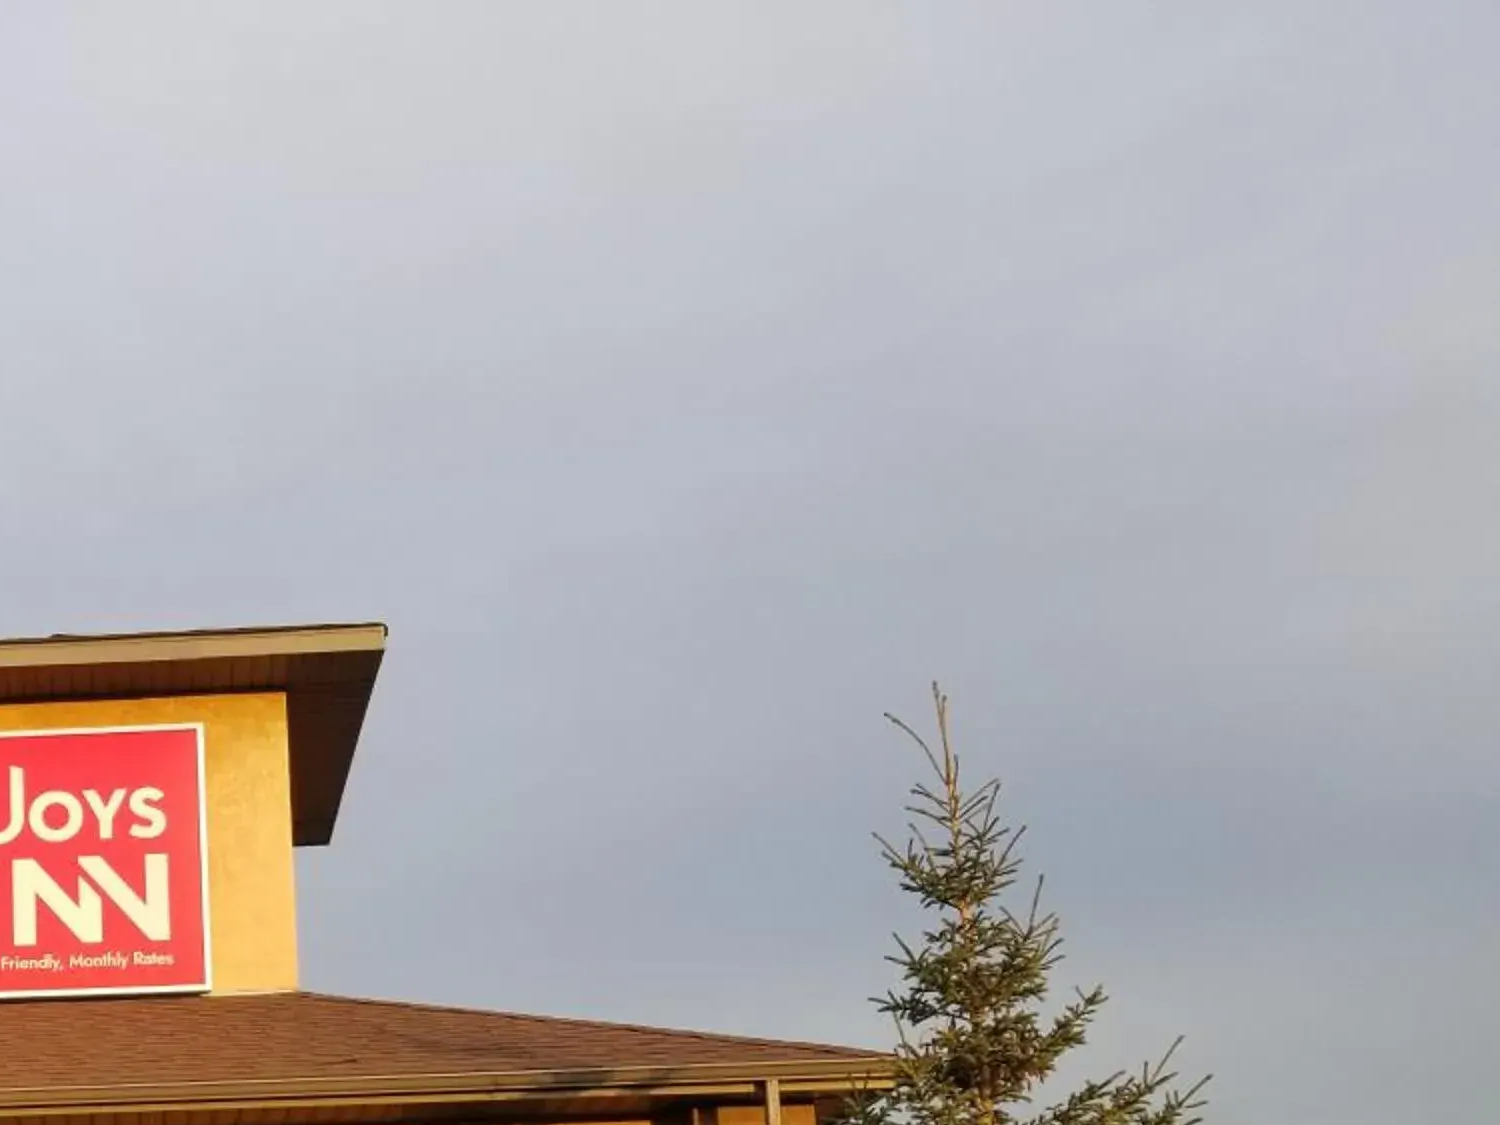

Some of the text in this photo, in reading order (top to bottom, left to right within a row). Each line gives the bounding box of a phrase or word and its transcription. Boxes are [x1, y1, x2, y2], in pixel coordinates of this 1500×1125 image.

[0, 954, 65, 973] Friendly,
[68, 951, 129, 970] Monthly
[132, 950, 175, 967] Rates
